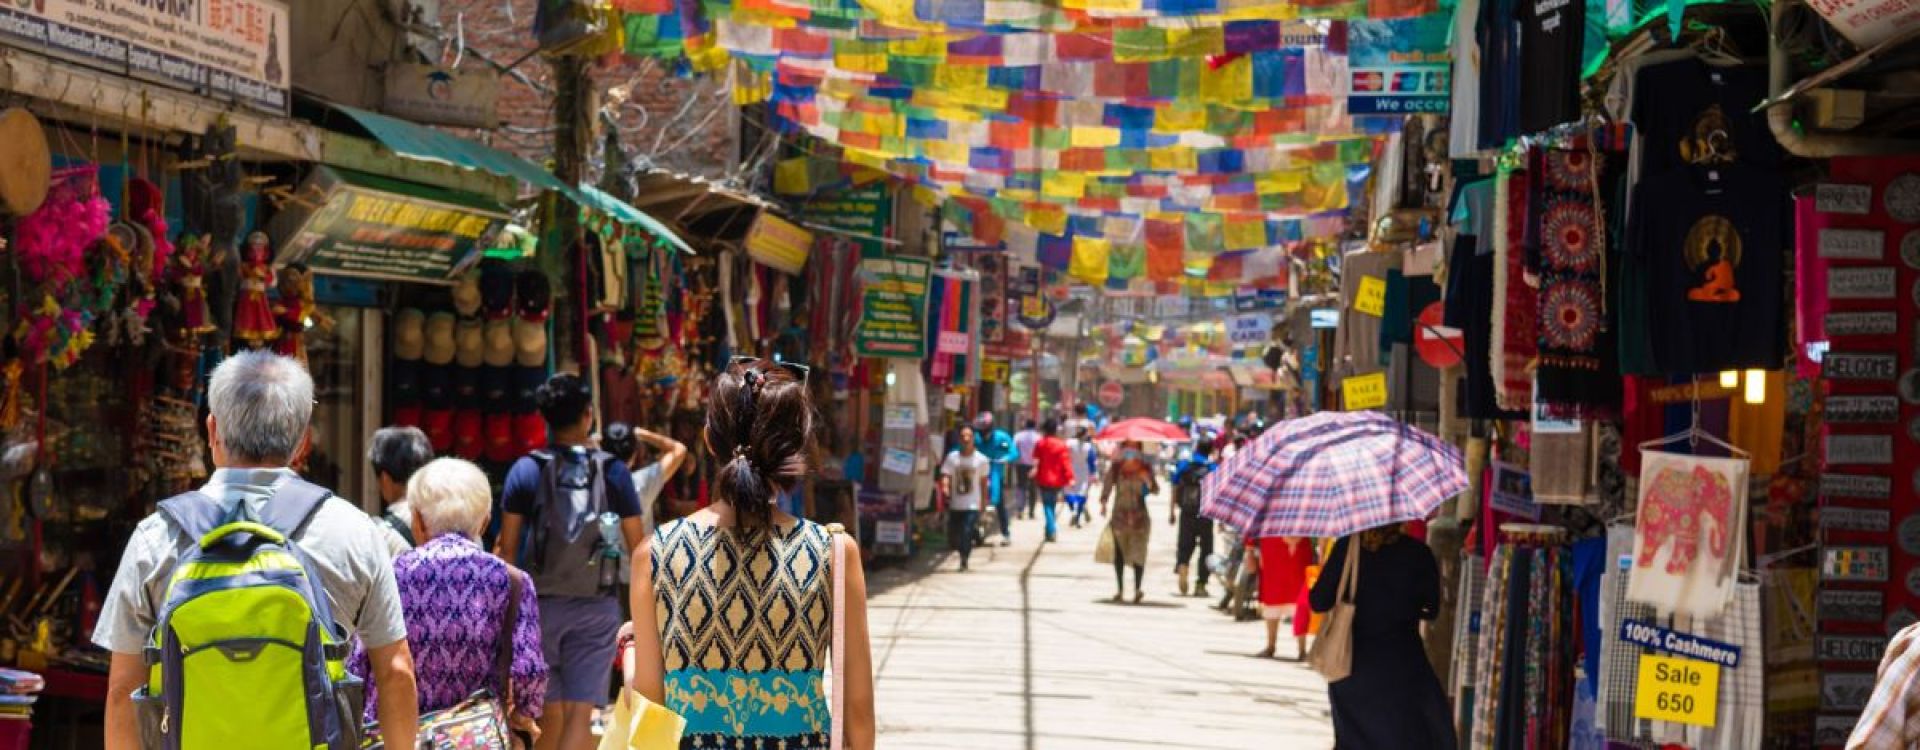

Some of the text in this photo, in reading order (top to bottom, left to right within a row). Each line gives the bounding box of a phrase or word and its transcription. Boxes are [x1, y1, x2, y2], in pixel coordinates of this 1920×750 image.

[1376, 99, 1399, 110] We
[1237, 319, 1257, 329] SIM
[1231, 331, 1266, 341] CARD
[1825, 357, 1896, 377] WELCOME
[1625, 622, 1737, 665] 100% Cashmere
[1655, 661, 1700, 686] Sale
[1657, 691, 1694, 714] 650
